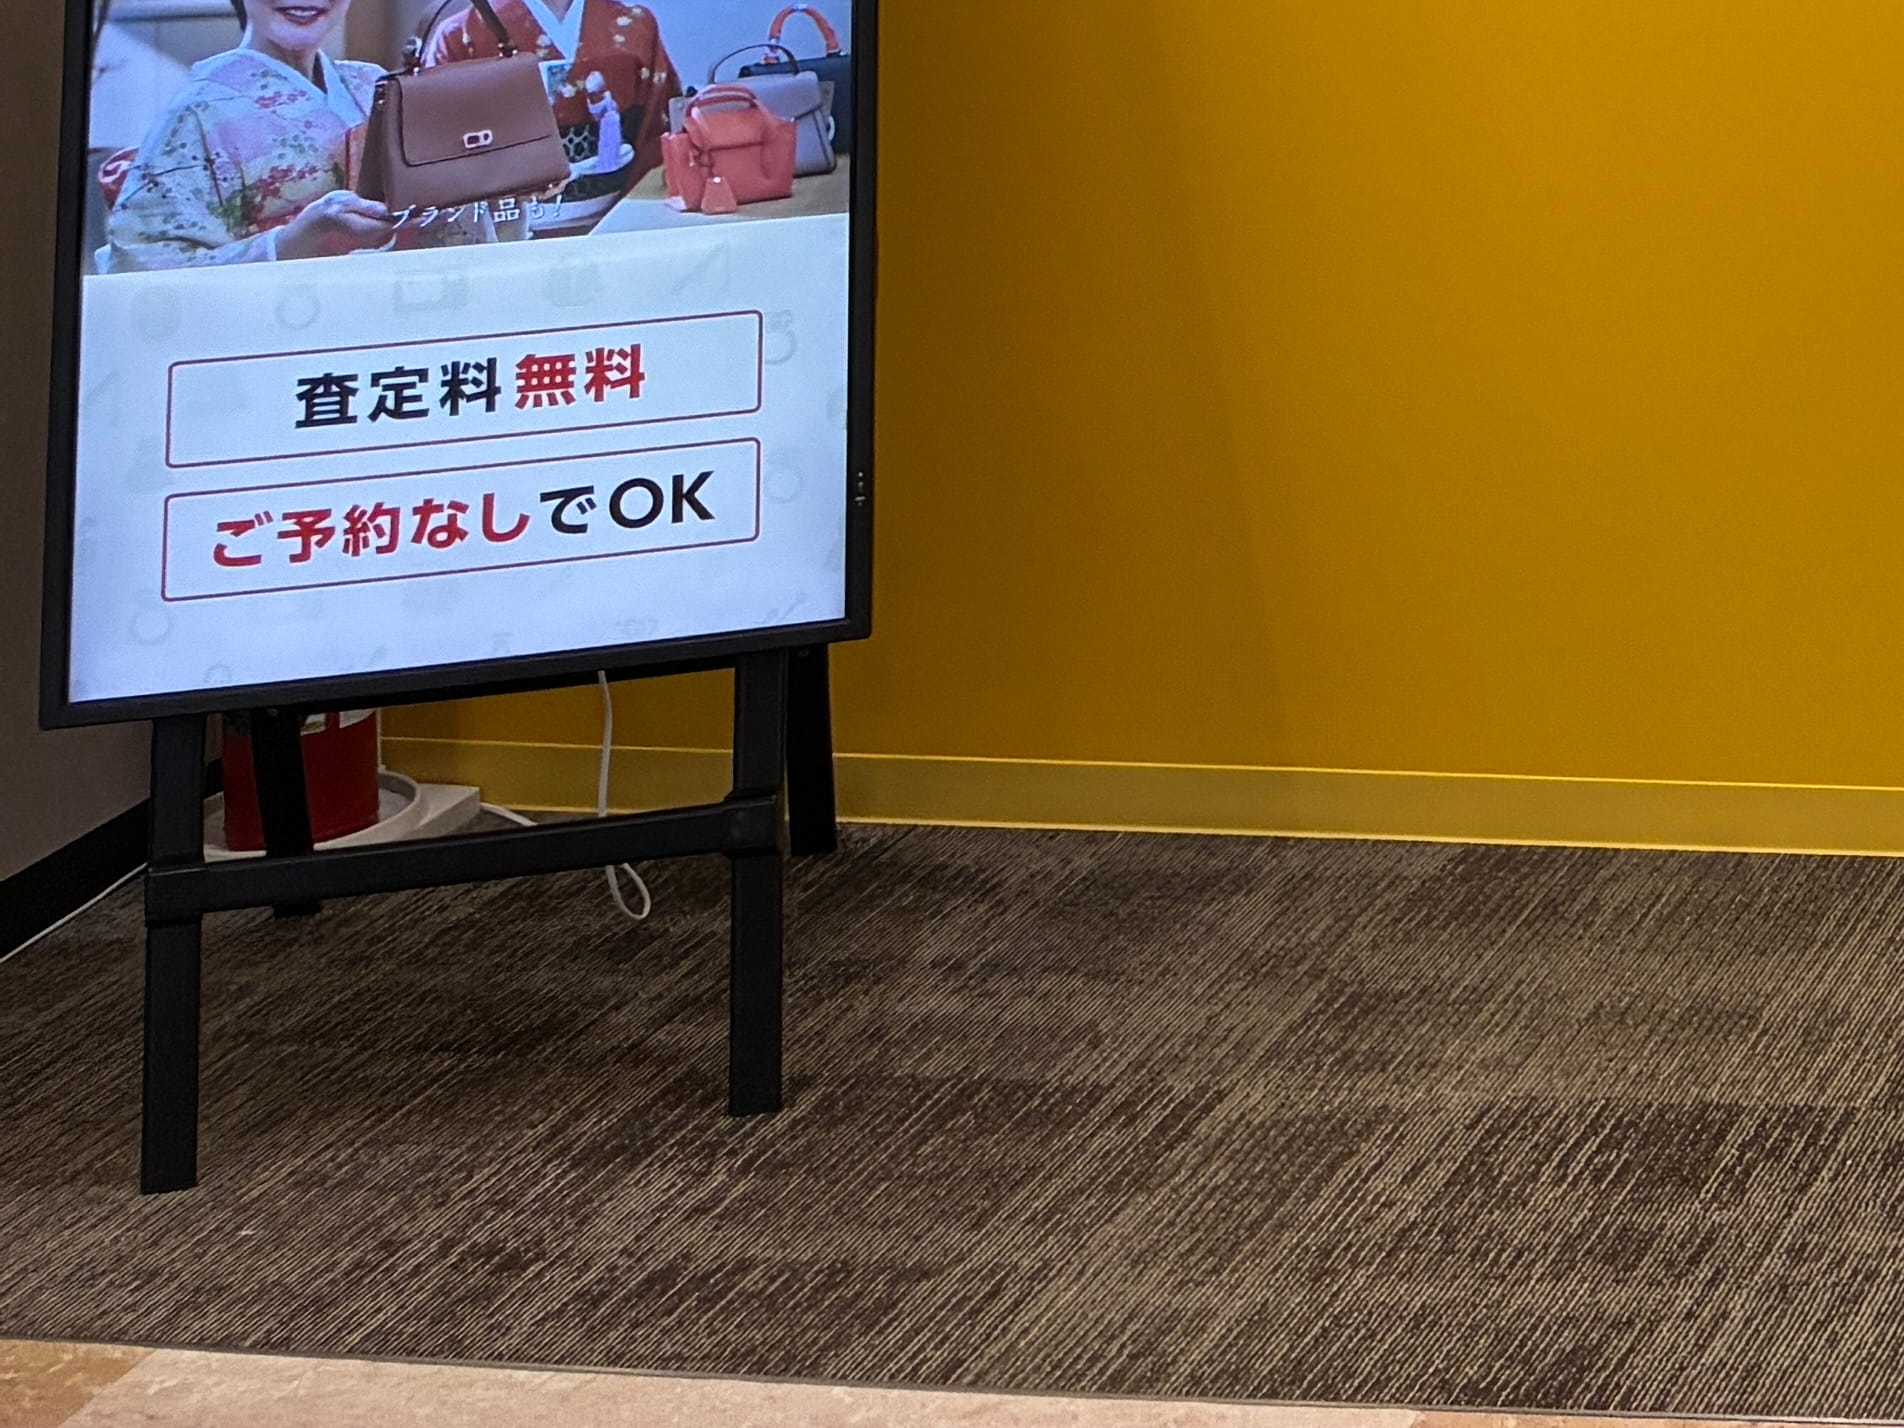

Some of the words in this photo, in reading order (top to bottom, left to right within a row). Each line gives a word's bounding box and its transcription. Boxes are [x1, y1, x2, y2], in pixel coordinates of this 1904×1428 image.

[294, 344, 646, 430] 査定料無料
[211, 471, 715, 568] ご予約なしでOK
